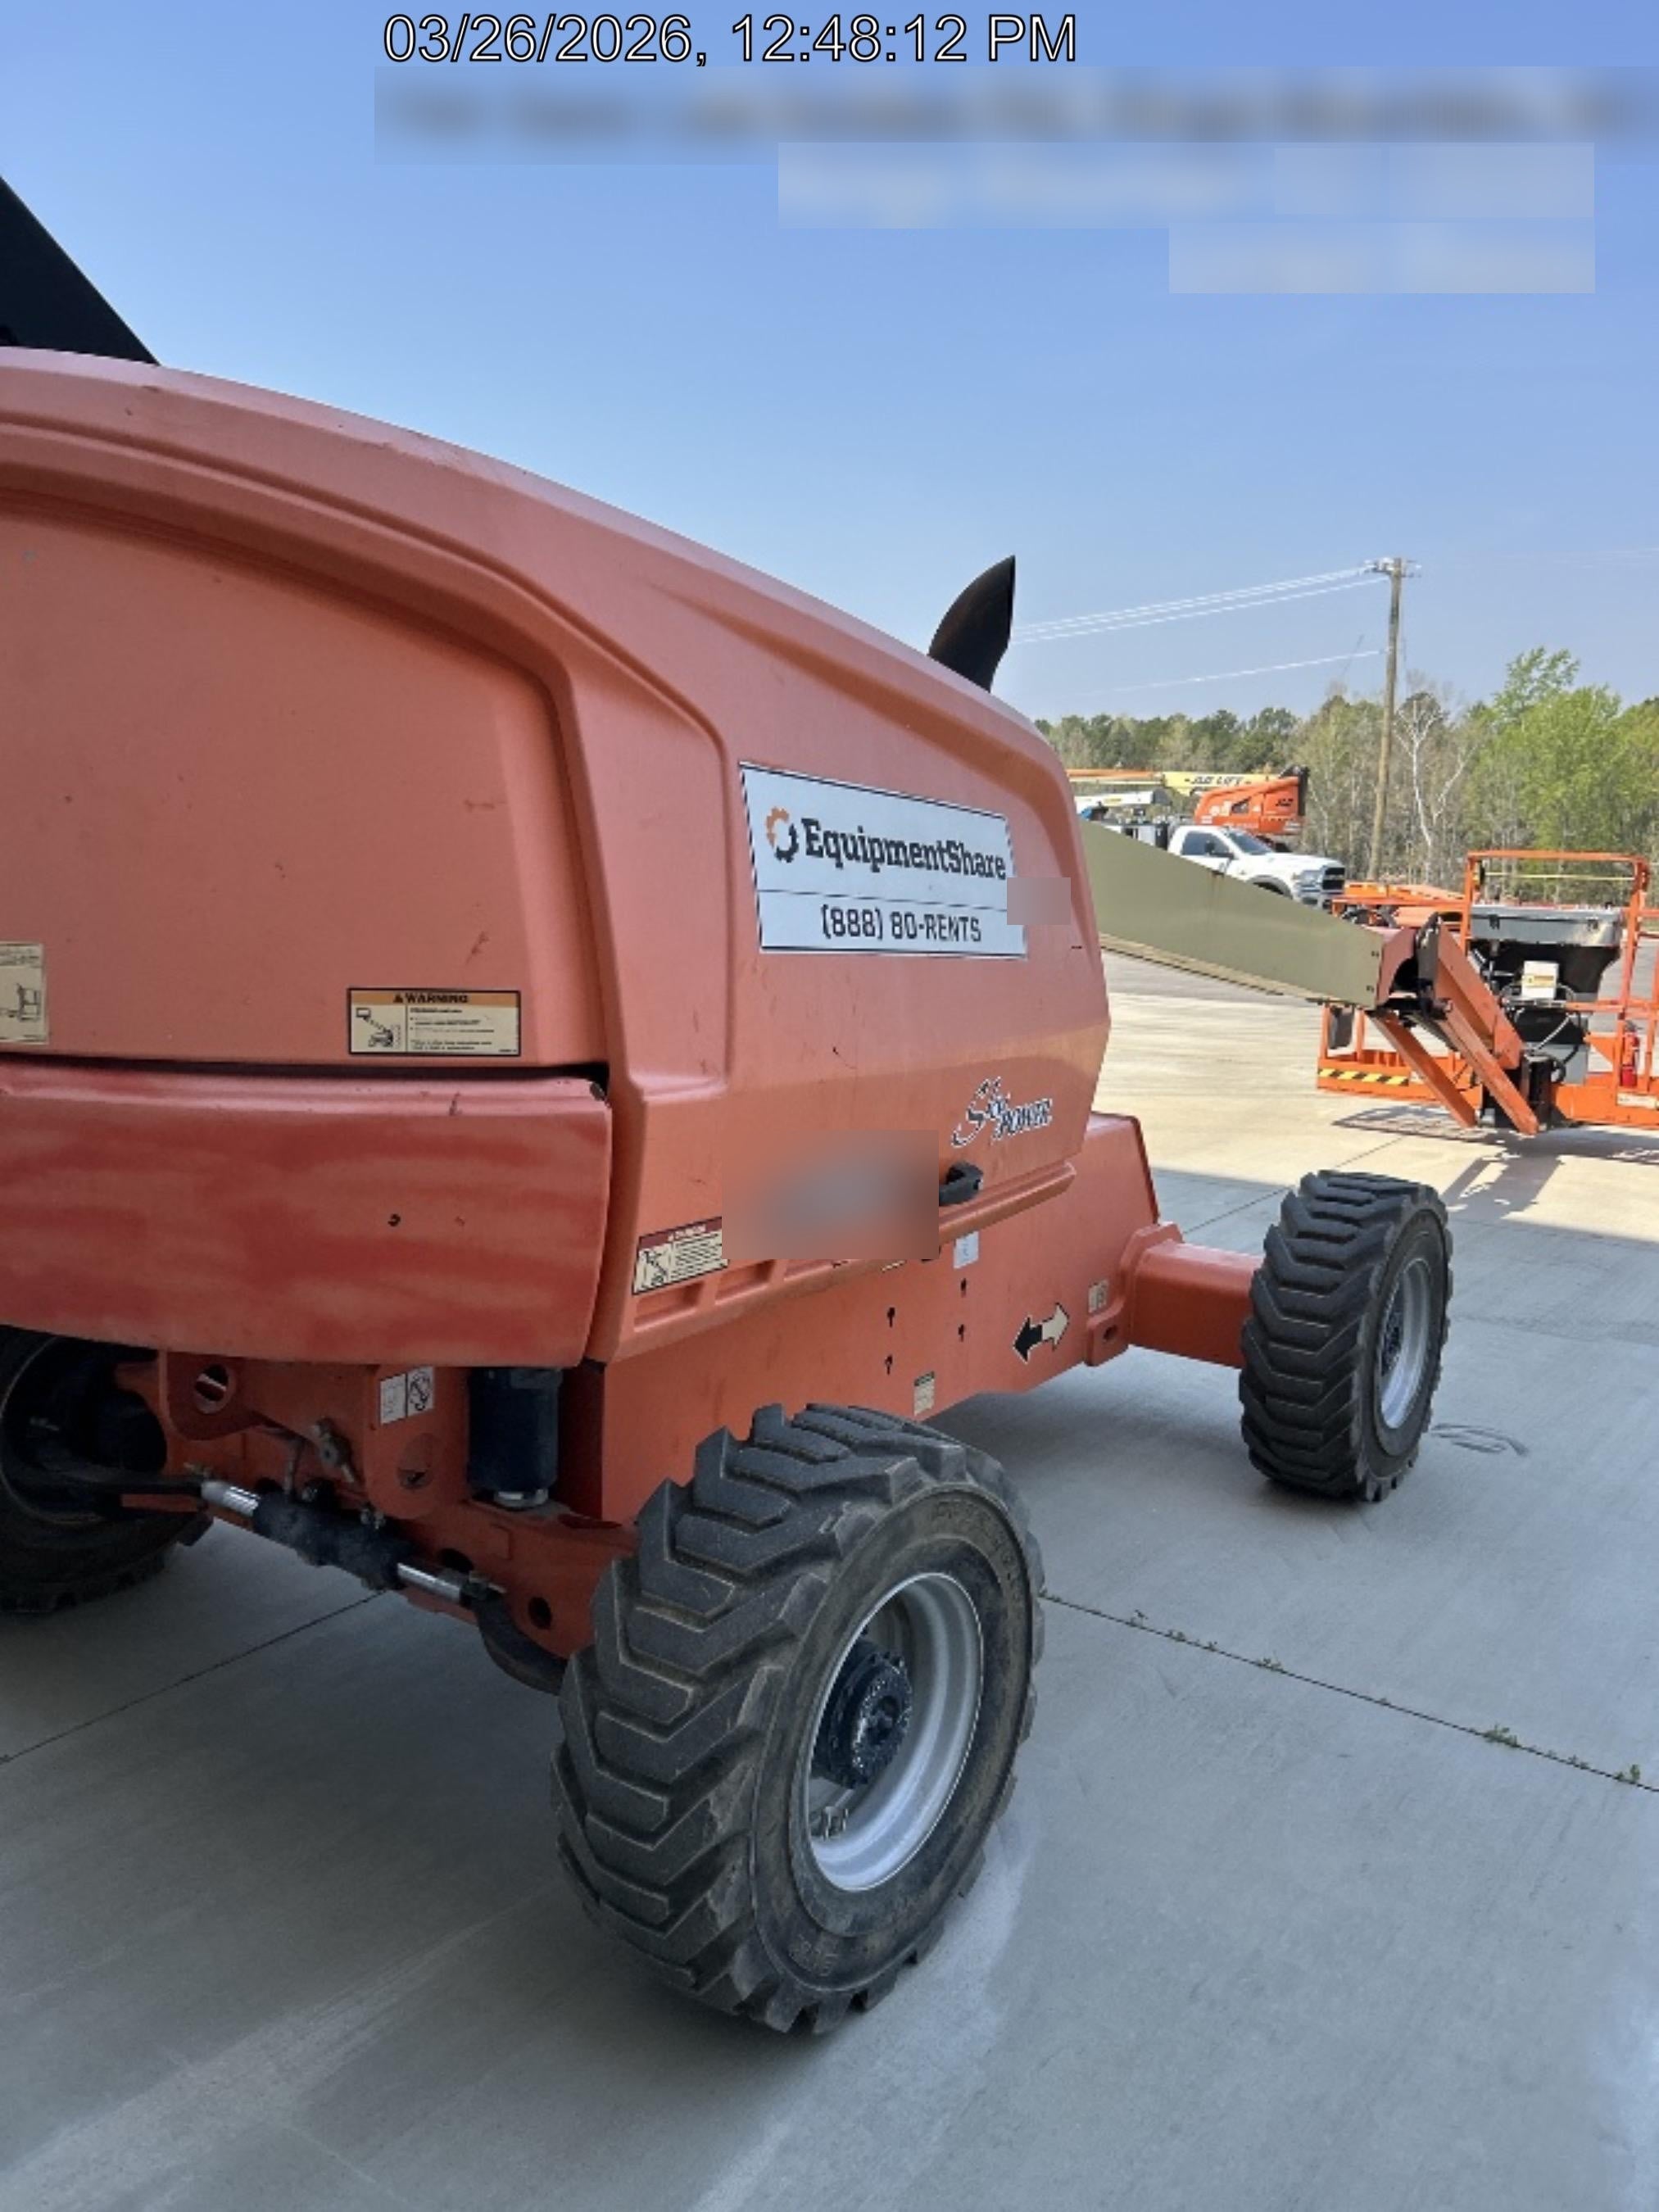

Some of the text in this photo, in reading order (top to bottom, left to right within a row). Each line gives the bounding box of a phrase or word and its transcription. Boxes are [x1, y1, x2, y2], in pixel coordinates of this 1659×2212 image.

[800, 818, 1007, 880] EquipmentShare
[822, 904, 982, 943] (888) 80-RENTS
[406, 992, 469, 1004] WARNING
